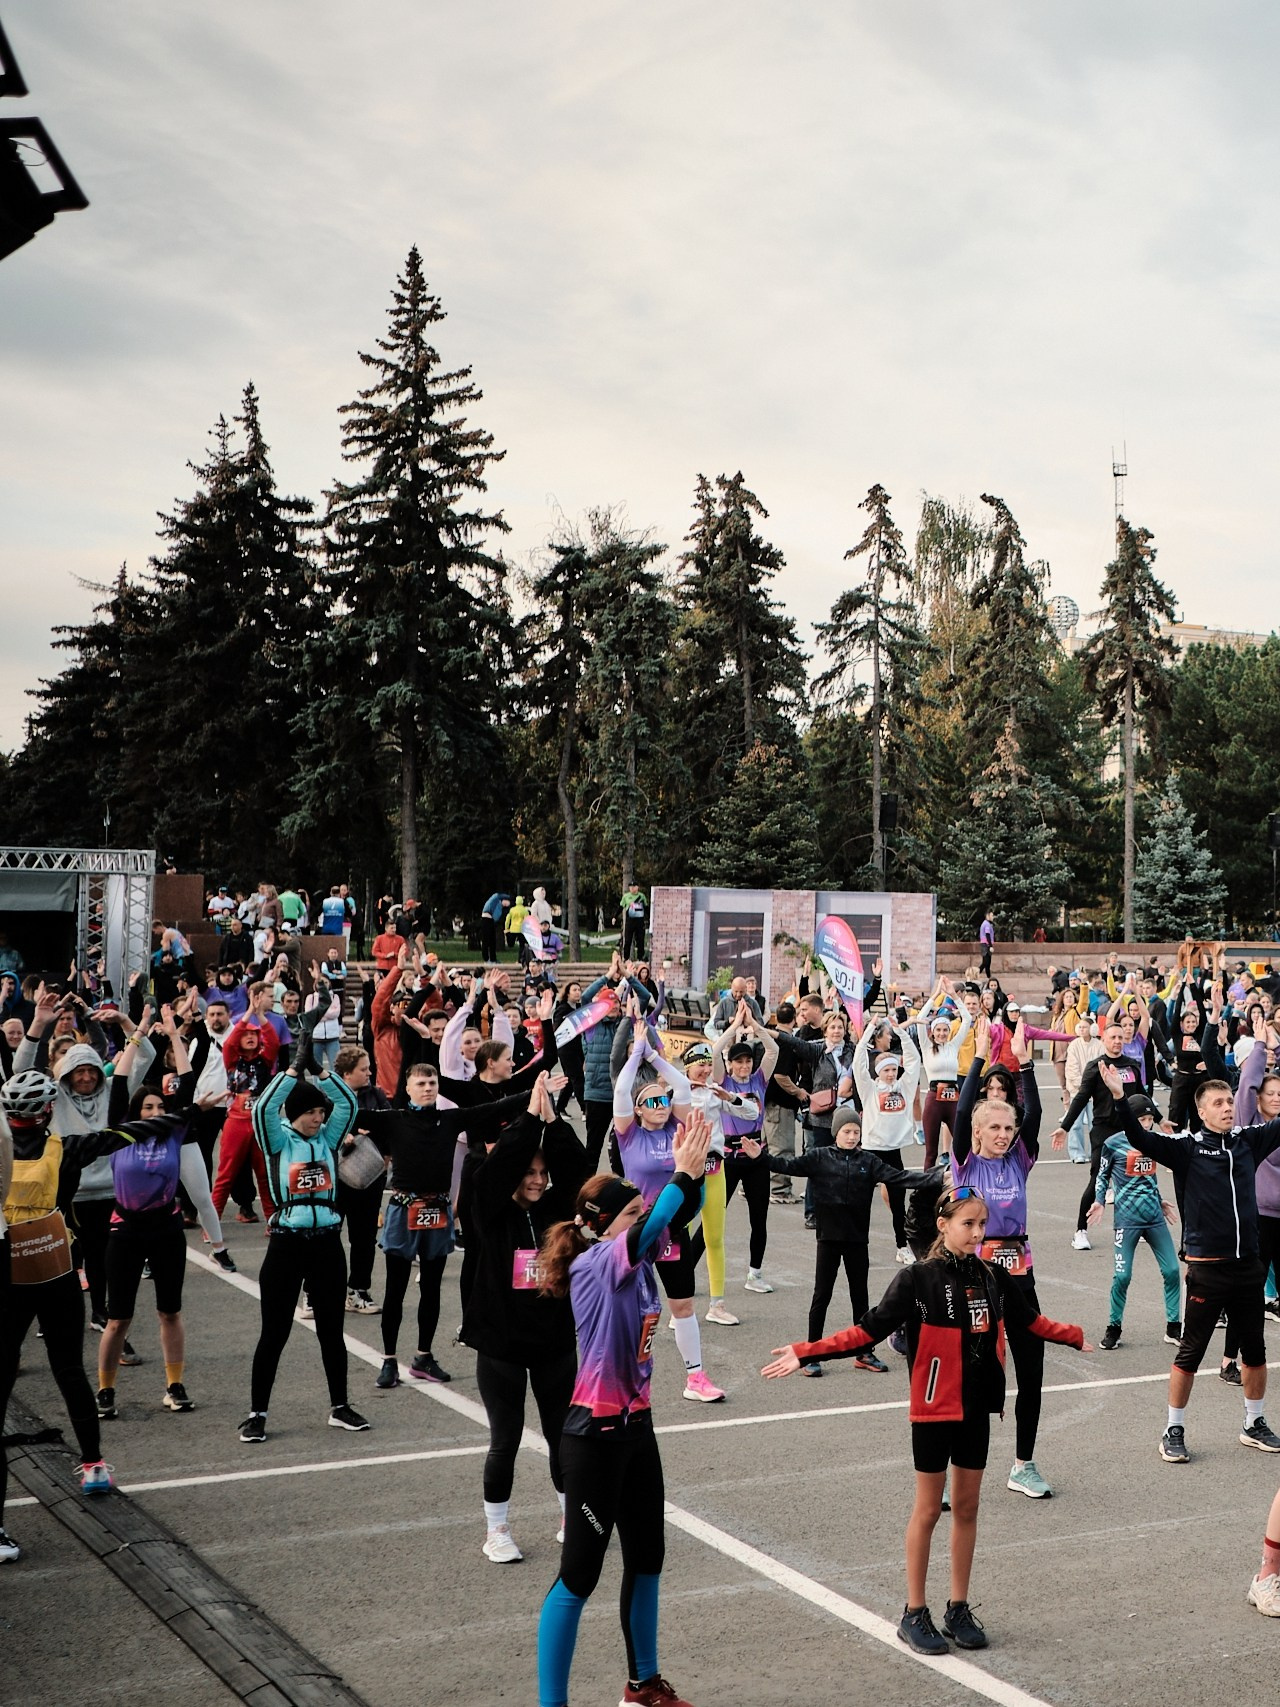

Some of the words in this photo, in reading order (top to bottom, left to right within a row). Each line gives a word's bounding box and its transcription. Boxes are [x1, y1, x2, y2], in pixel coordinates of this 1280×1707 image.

[1133, 1161, 1153, 1173] 2103
[297, 1174, 325, 1189] 2576
[22, 1238, 65, 1257] быстрее
[1114, 1253, 1126, 1273] ski
